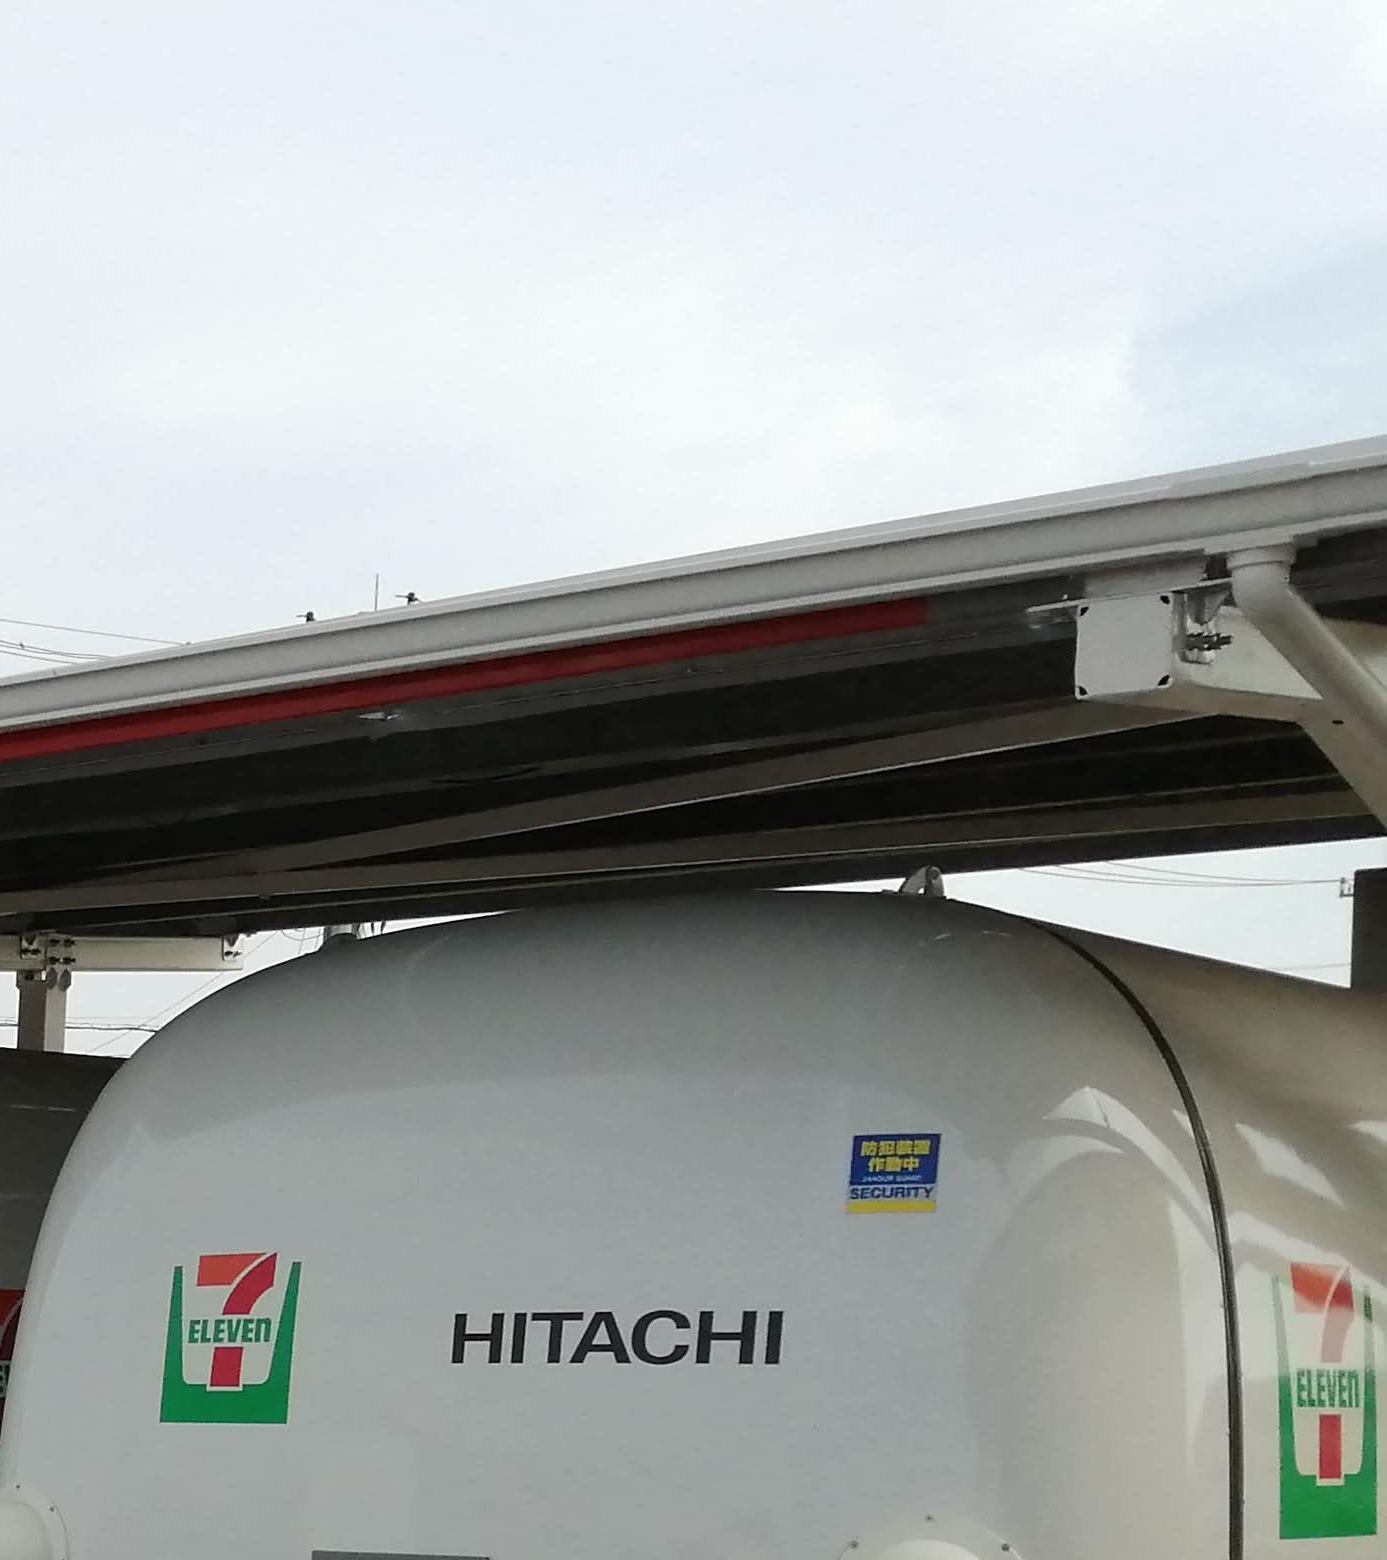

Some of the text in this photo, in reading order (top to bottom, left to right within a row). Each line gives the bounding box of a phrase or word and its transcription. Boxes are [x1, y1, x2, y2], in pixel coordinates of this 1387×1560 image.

[868, 1156, 919, 1172] 作動中
[850, 1186, 934, 1200] SECURITY
[197, 1252, 278, 1388] 7
[450, 1310, 784, 1366] HITACHI
